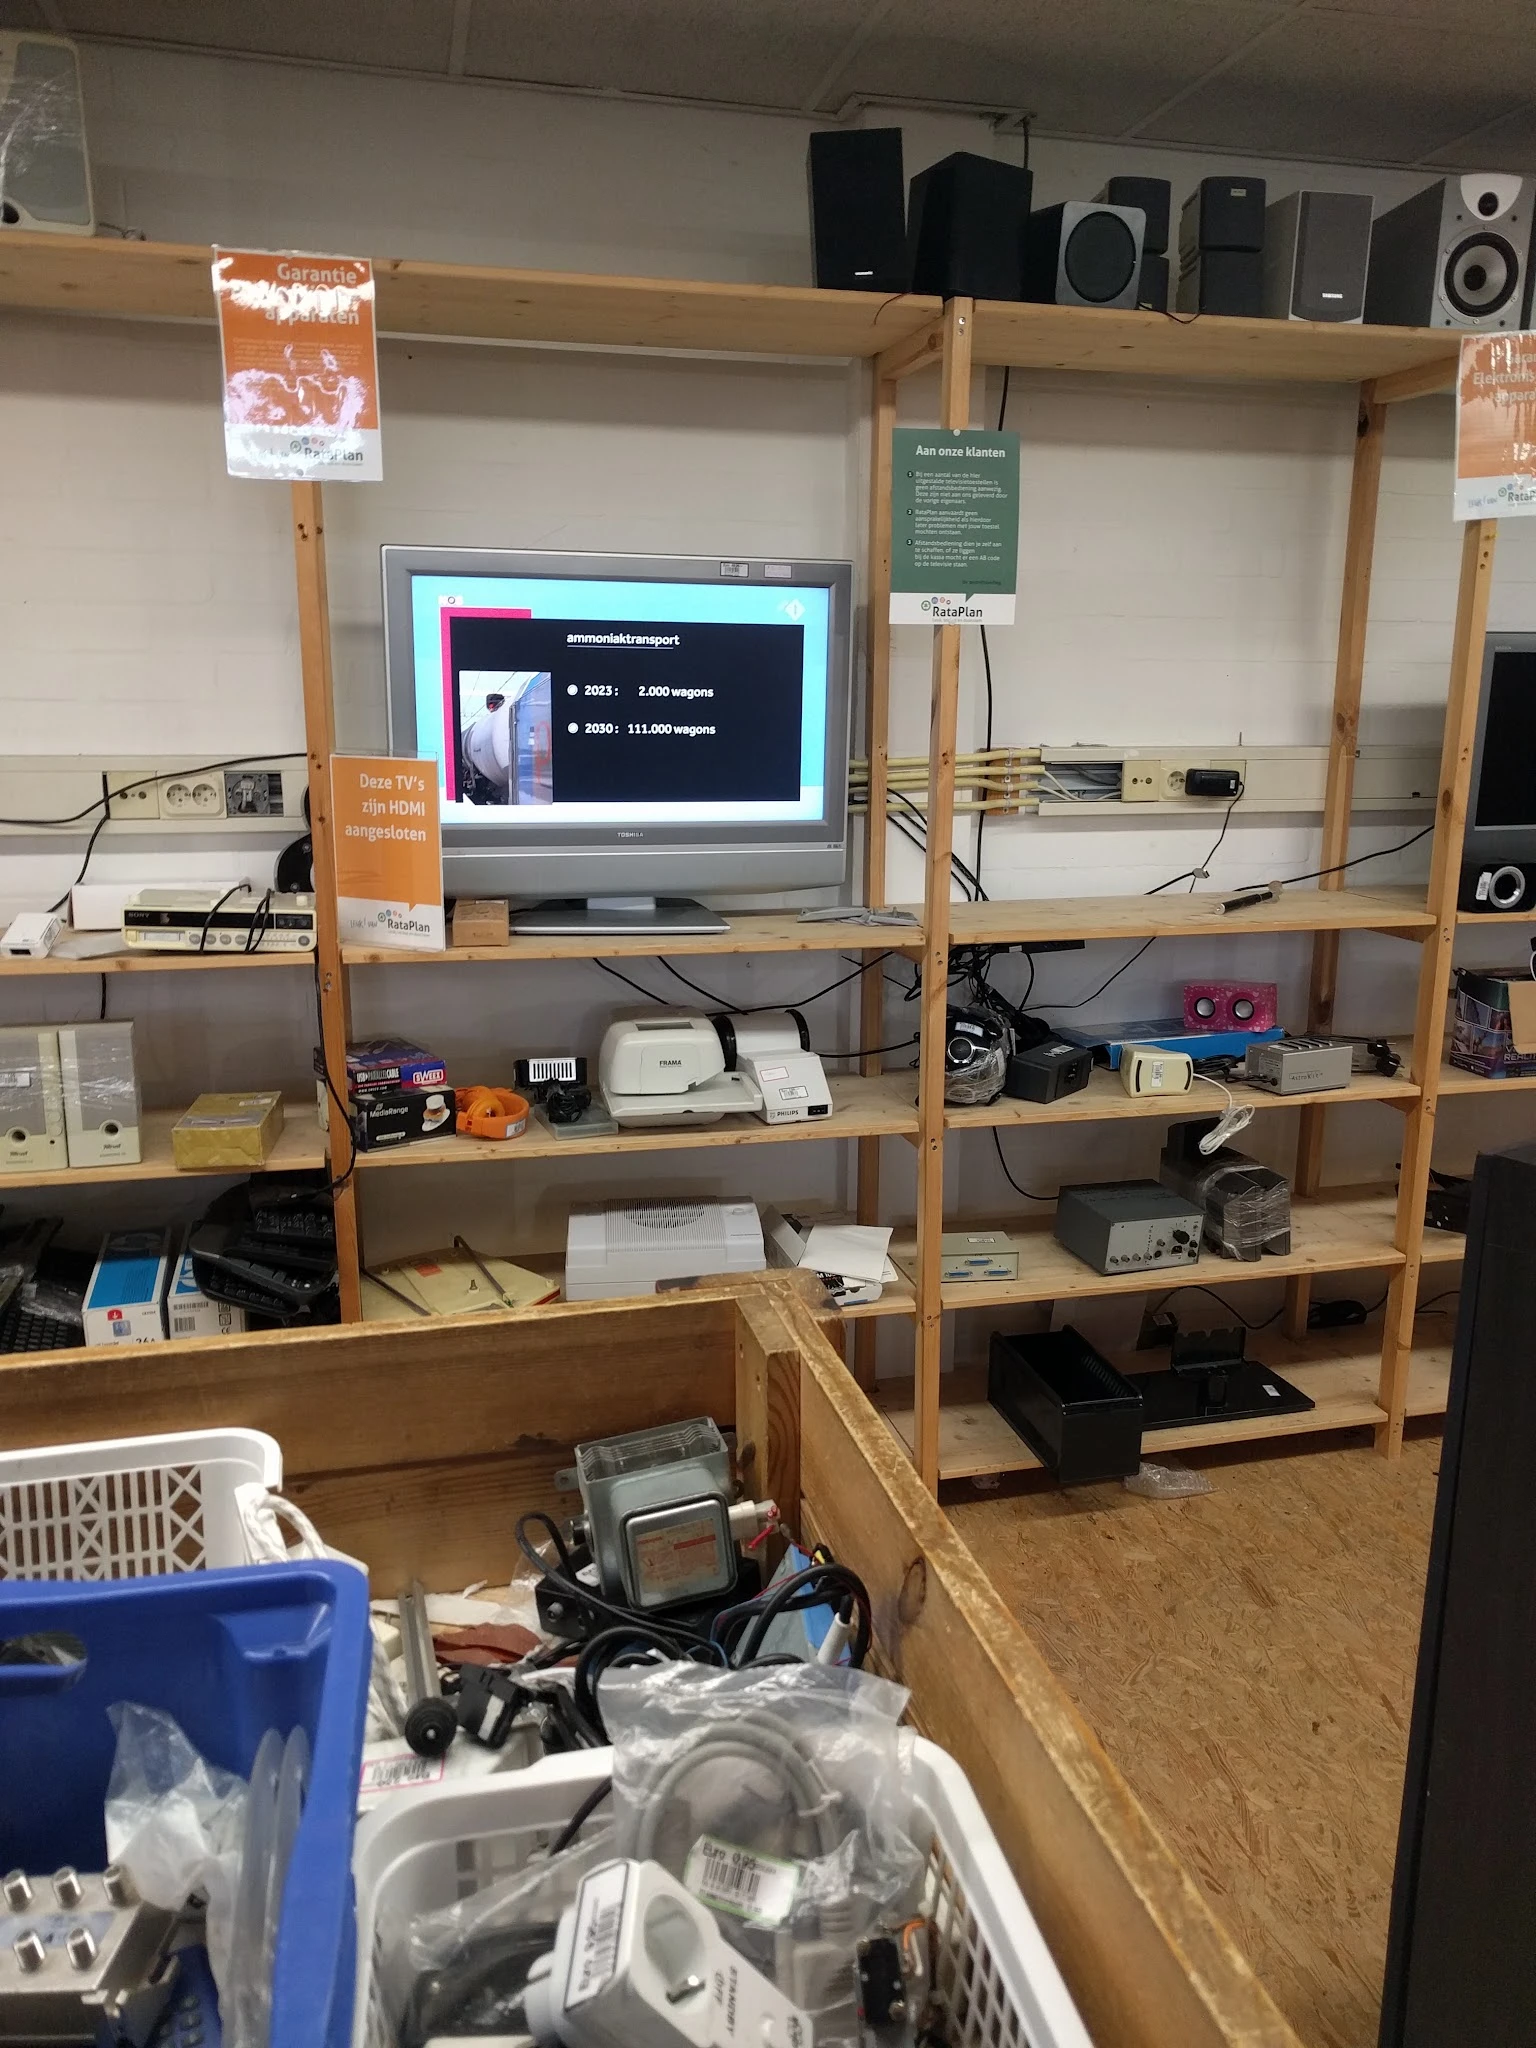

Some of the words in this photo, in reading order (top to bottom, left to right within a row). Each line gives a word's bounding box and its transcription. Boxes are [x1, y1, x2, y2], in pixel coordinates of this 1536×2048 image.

[277, 262, 357, 284] Garantie
[916, 445, 936, 456] Aan
[938, 447, 964, 457] onze
[966, 446, 1006, 458] klanten
[932, 606, 982, 618] RataPlan
[566, 633, 680, 647] ammoniaktransport
[638, 686, 670, 696] 2.000
[671, 688, 714, 699] wagons
[628, 724, 672, 734] 111.000
[673, 726, 716, 737] wagons
[360, 773, 392, 790] Deze
[396, 775, 425, 790] TV's
[362, 799, 386, 816] zijn
[389, 800, 426, 816] HDMI
[345, 824, 426, 842] aangesloten
[387, 918, 430, 932] RataPlan
[369, 1106, 408, 1118] MediaRange
[702, 1842, 726, 1860] Euro
